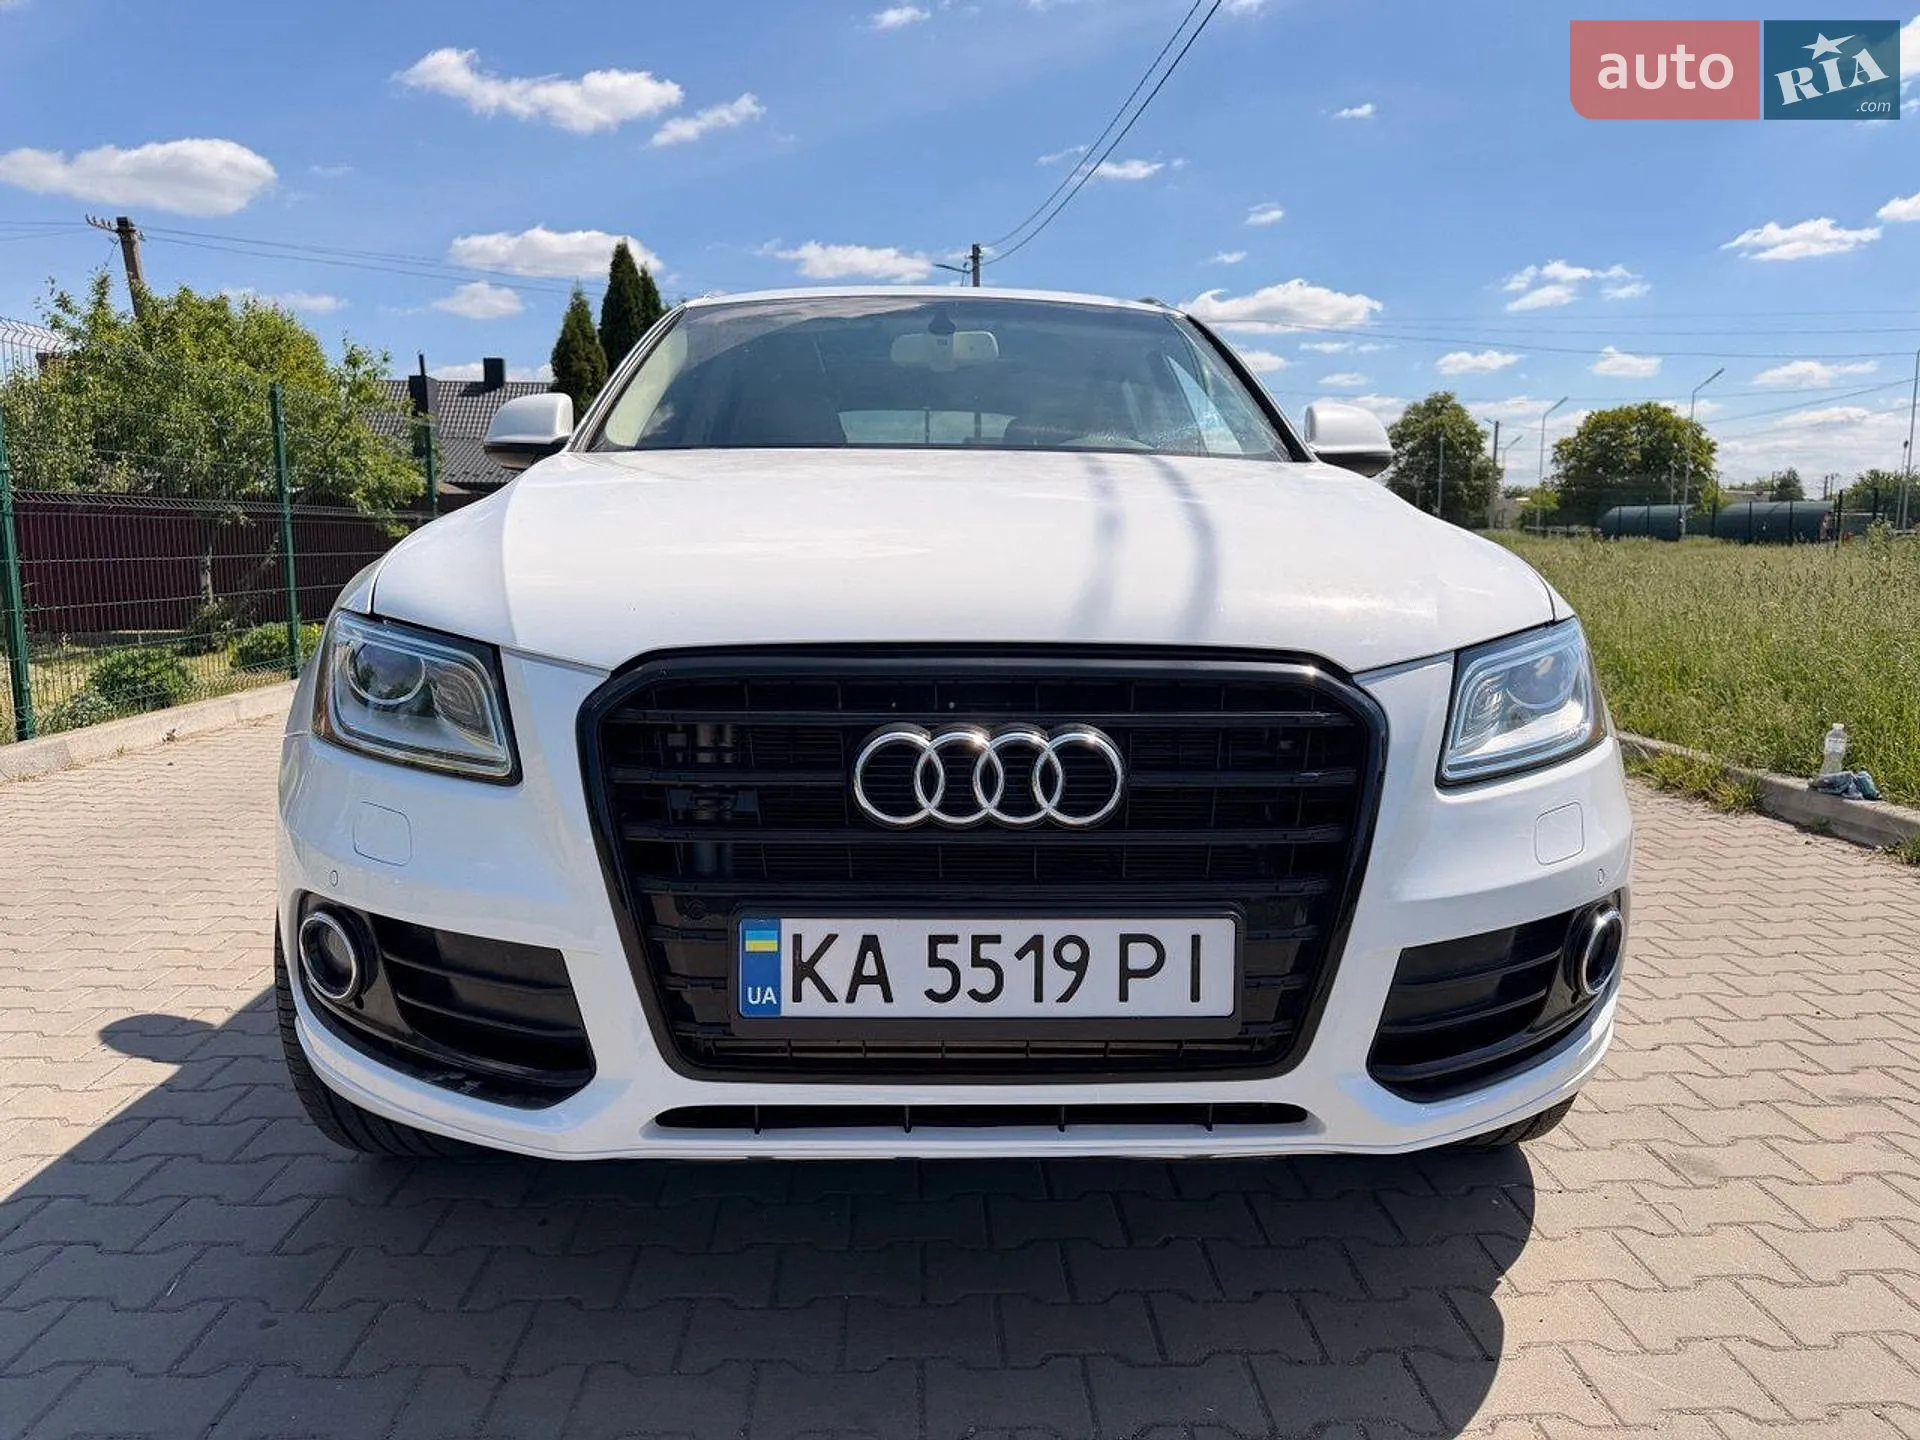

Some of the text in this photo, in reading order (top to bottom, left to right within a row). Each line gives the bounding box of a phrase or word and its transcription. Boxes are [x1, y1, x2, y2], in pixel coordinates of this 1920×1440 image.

[791, 933, 1201, 1003] KA 5519 PI
[747, 986, 777, 1005] UA
